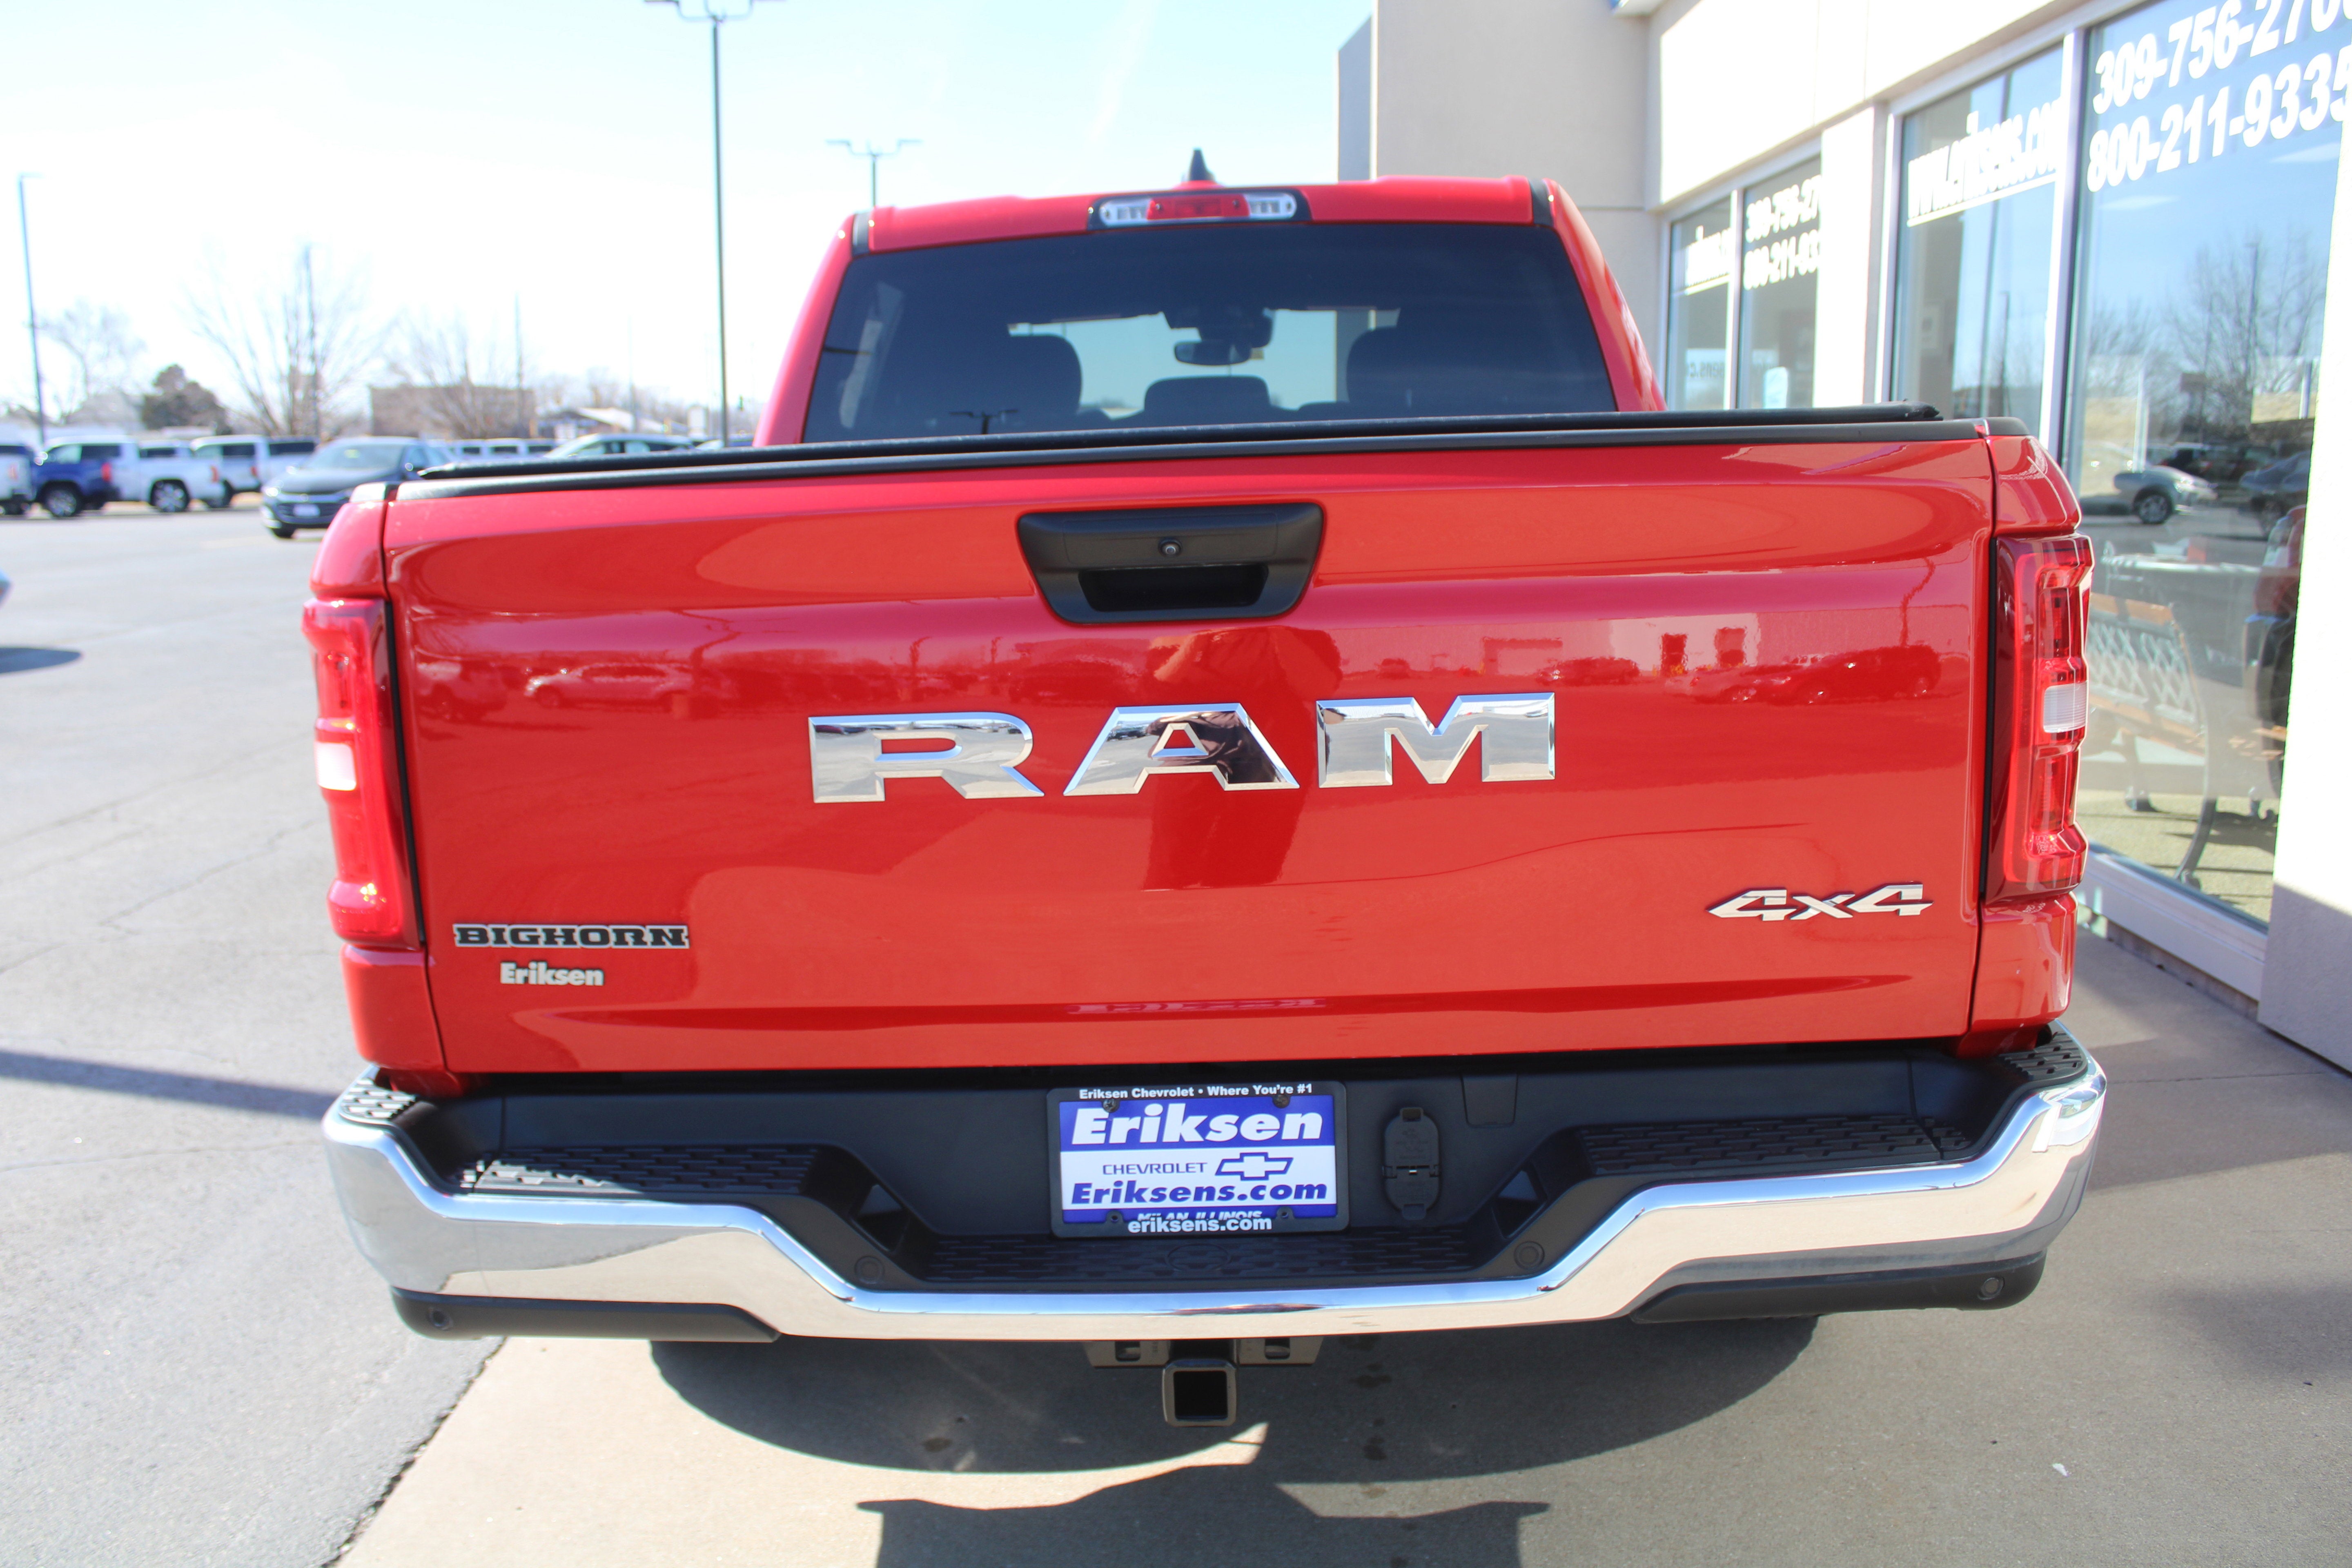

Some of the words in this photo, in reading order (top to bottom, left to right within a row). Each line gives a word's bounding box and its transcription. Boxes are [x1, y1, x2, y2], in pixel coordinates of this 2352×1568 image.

[808, 692, 1556, 804] RAM
[1706, 883, 1934, 921] 4x4
[453, 924, 690, 949] BIGHORN
[500, 961, 604, 985] Eriksen
[1079, 1089, 1128, 1099] Eriksen
[1131, 1087, 1194, 1098] Chevrolet
[1207, 1086, 1249, 1096] Where
[1252, 1084, 1294, 1095] You're
[1297, 1084, 1312, 1094] #1
[1071, 1103, 1323, 1144] Eriksen
[1102, 1162, 1207, 1175] CHEVROLET
[1071, 1180, 1327, 1204] Eriksens.com
[1128, 1217, 1272, 1233] eriksens.com
